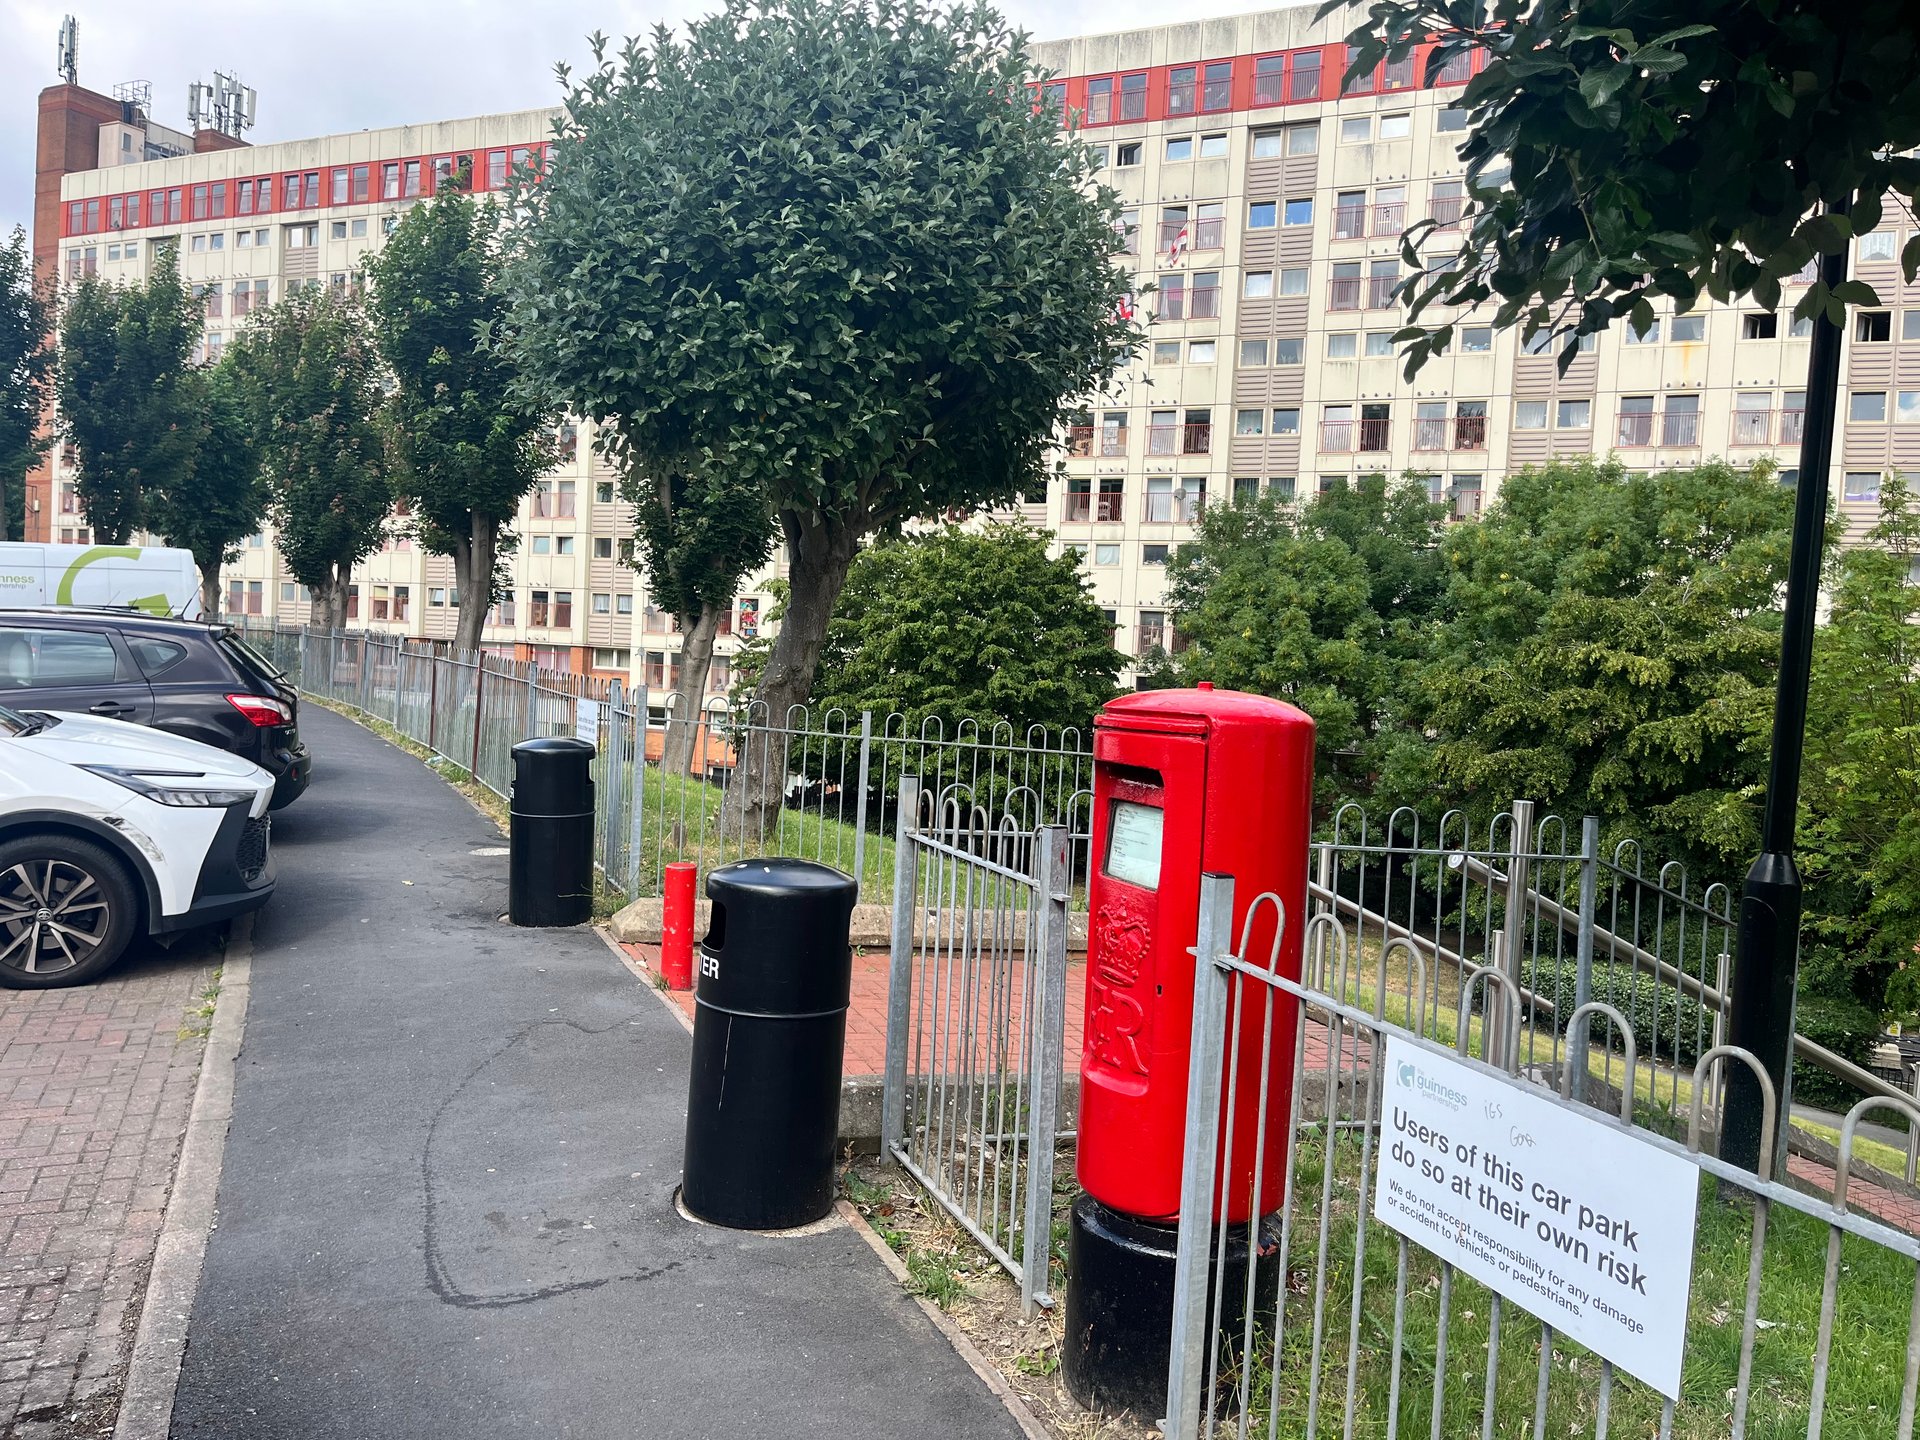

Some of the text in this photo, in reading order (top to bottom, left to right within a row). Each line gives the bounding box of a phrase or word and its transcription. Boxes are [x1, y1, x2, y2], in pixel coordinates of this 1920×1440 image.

[1417, 1075, 1468, 1106] guinness
[1392, 1140, 1647, 1296] do so at their own risk
[1393, 1106, 1639, 1253] Users of this car park
[1387, 1196, 1583, 1318] or accident to vehicles or pedestrians.
[1389, 1178, 1644, 1334] We do not accept responsibility for any damage
